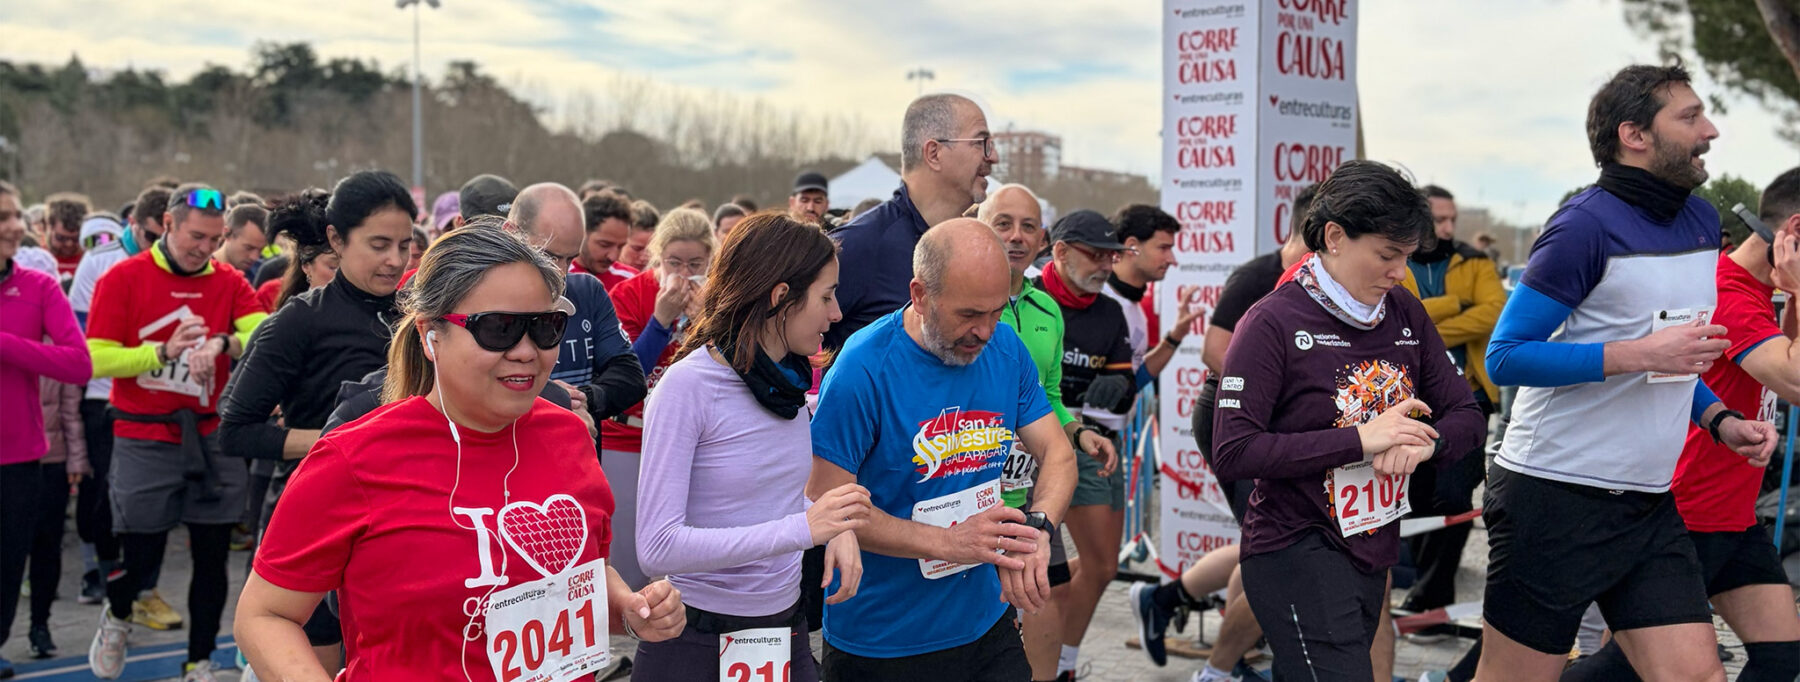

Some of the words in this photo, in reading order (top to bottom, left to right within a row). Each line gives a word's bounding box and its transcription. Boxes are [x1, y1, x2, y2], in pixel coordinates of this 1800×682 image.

[1182, 4, 1245, 18] entreculturas
[1178, 27, 1240, 53] CORRE
[1277, 32, 1345, 81] CAUSA
[1179, 59, 1236, 84] CAUSA
[1279, 98, 1351, 120] entreculturas
[1178, 114, 1238, 139] CORRE
[1178, 146, 1235, 169] CAUSA
[1177, 200, 1236, 225] CORRE
[1177, 231, 1235, 253] CAUSA
[932, 406, 960, 434] 47
[944, 444, 1008, 466] GALAPAGAR
[923, 500, 961, 513] entreculturas
[977, 497, 995, 510] CAUSA
[1341, 474, 1406, 519] 2102
[453, 507, 509, 588] I
[567, 568, 595, 587] CORRE
[494, 588, 546, 610] entreculturas
[567, 583, 595, 602] CAUSA
[494, 599, 595, 682] 2041
[734, 636, 782, 645] entreculturas
